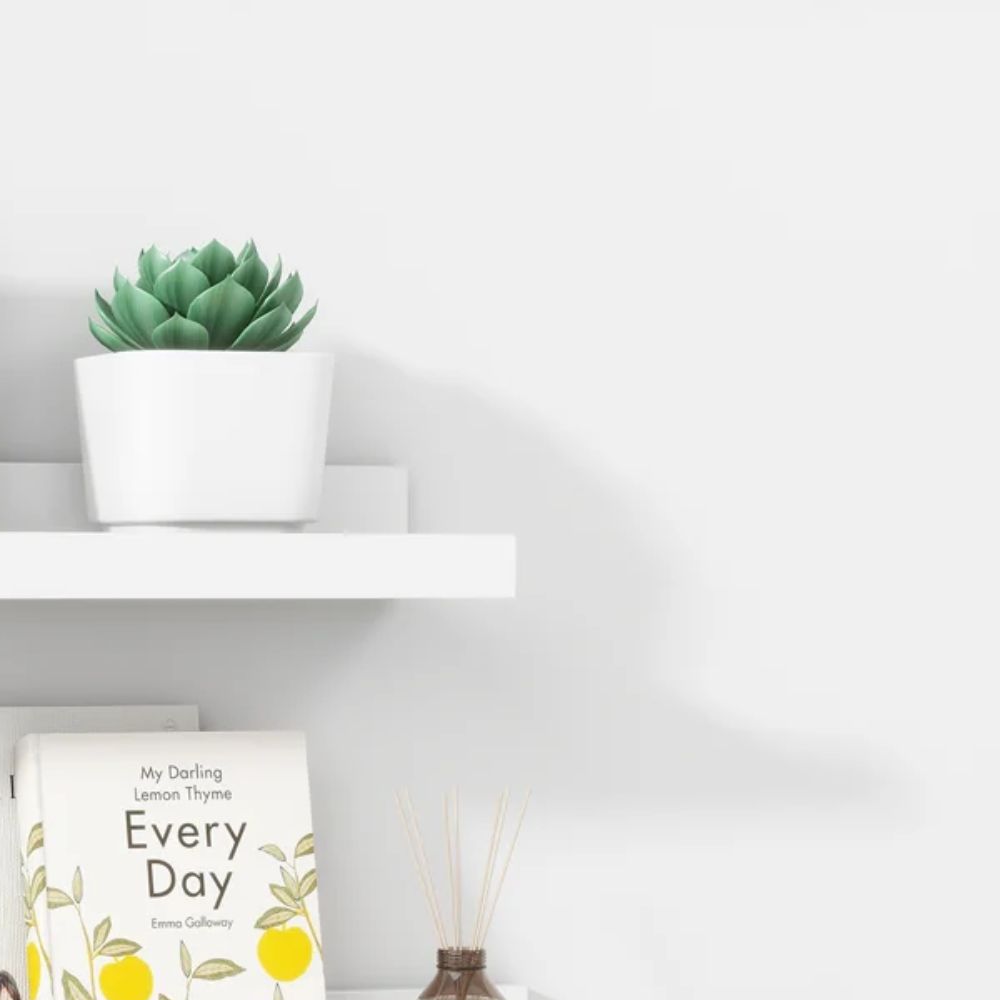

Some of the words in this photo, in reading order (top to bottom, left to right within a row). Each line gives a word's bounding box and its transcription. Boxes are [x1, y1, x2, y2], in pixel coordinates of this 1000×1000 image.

[140, 766, 163, 784] My
[168, 763, 222, 783] Darling
[134, 788, 180, 801] Lemon
[185, 785, 232, 804] Thyme
[125, 810, 247, 860] Every
[147, 859, 233, 910] Day
[151, 917, 182, 929] Emma
[185, 916, 233, 930] Galloway
